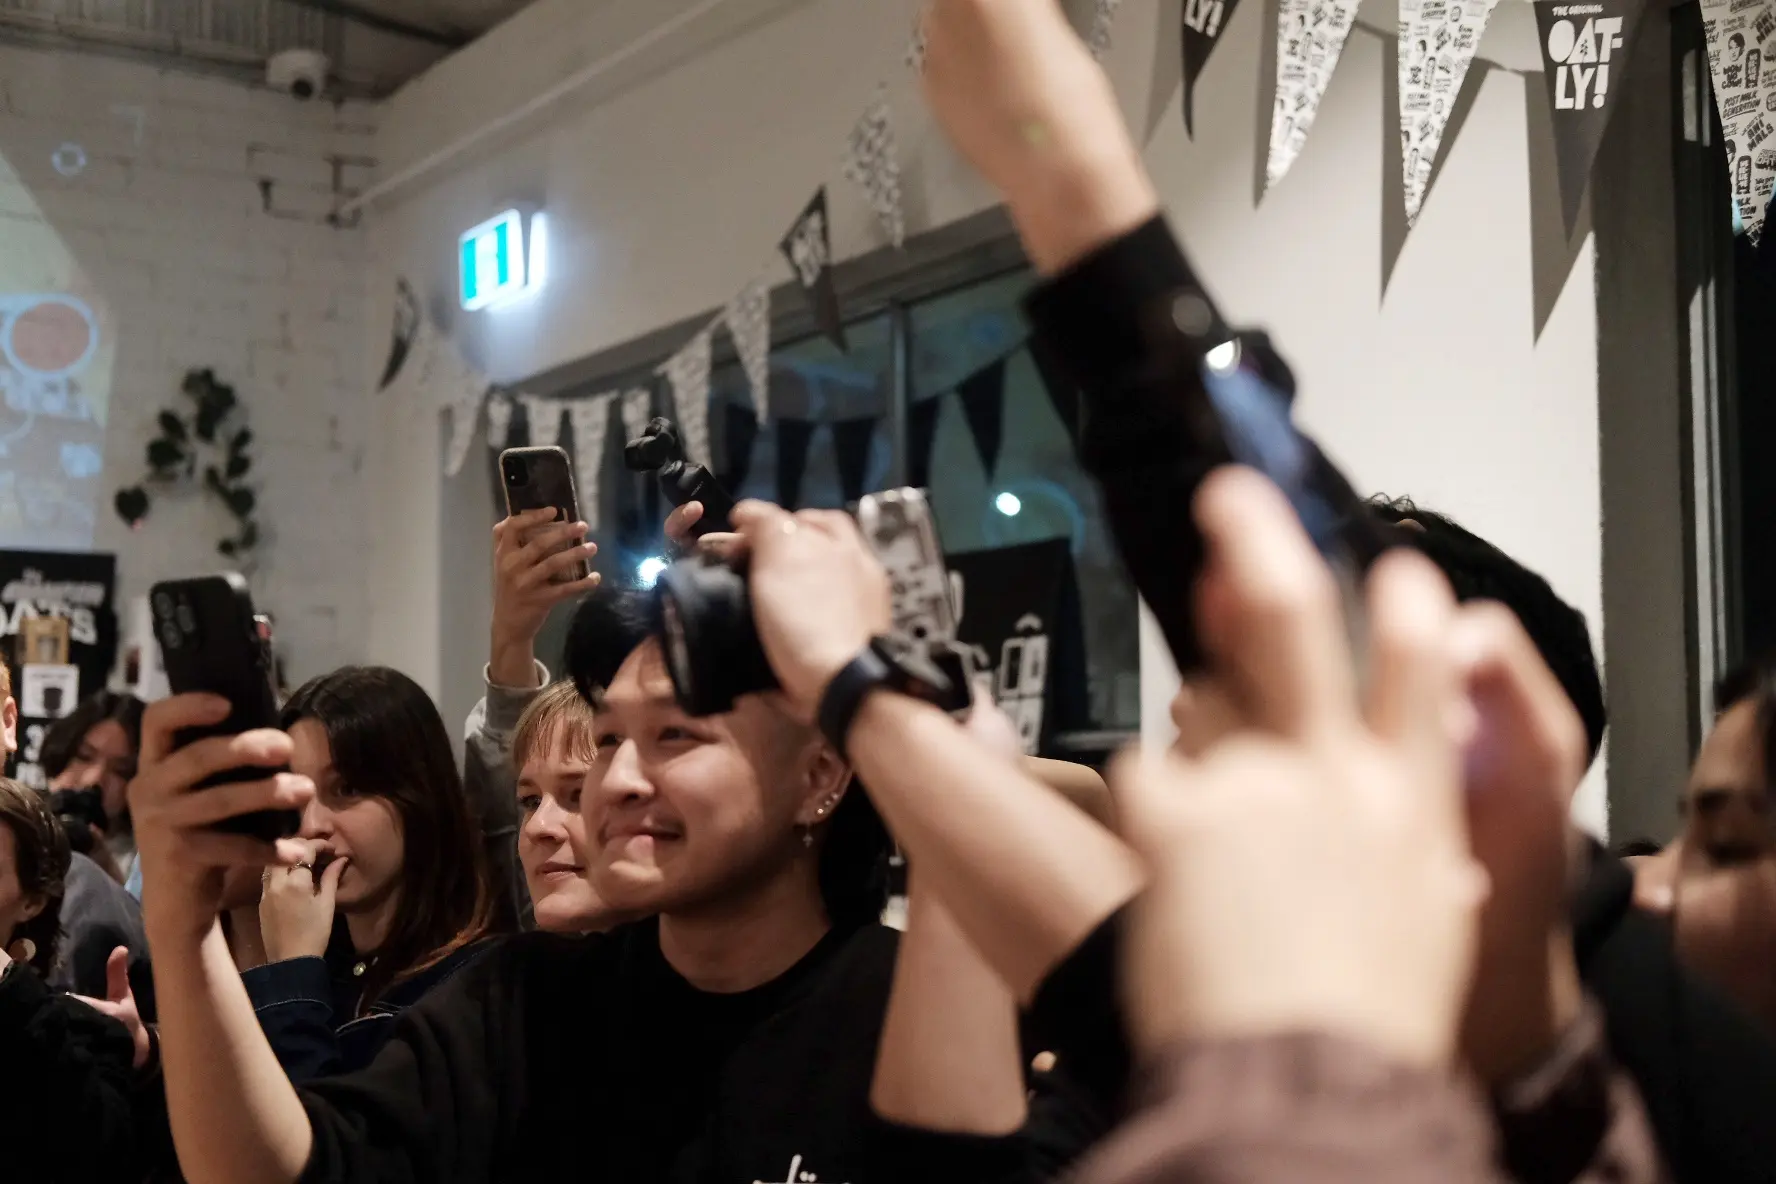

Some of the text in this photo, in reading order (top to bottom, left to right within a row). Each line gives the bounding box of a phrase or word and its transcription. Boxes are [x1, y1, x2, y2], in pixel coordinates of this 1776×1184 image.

[1552, 4, 1603, 16] THE ORIGINAL
[1555, 64, 1609, 110] LY!
[1723, 90, 1758, 109] POST MILK
[1723, 98, 1761, 119] GENERATION
